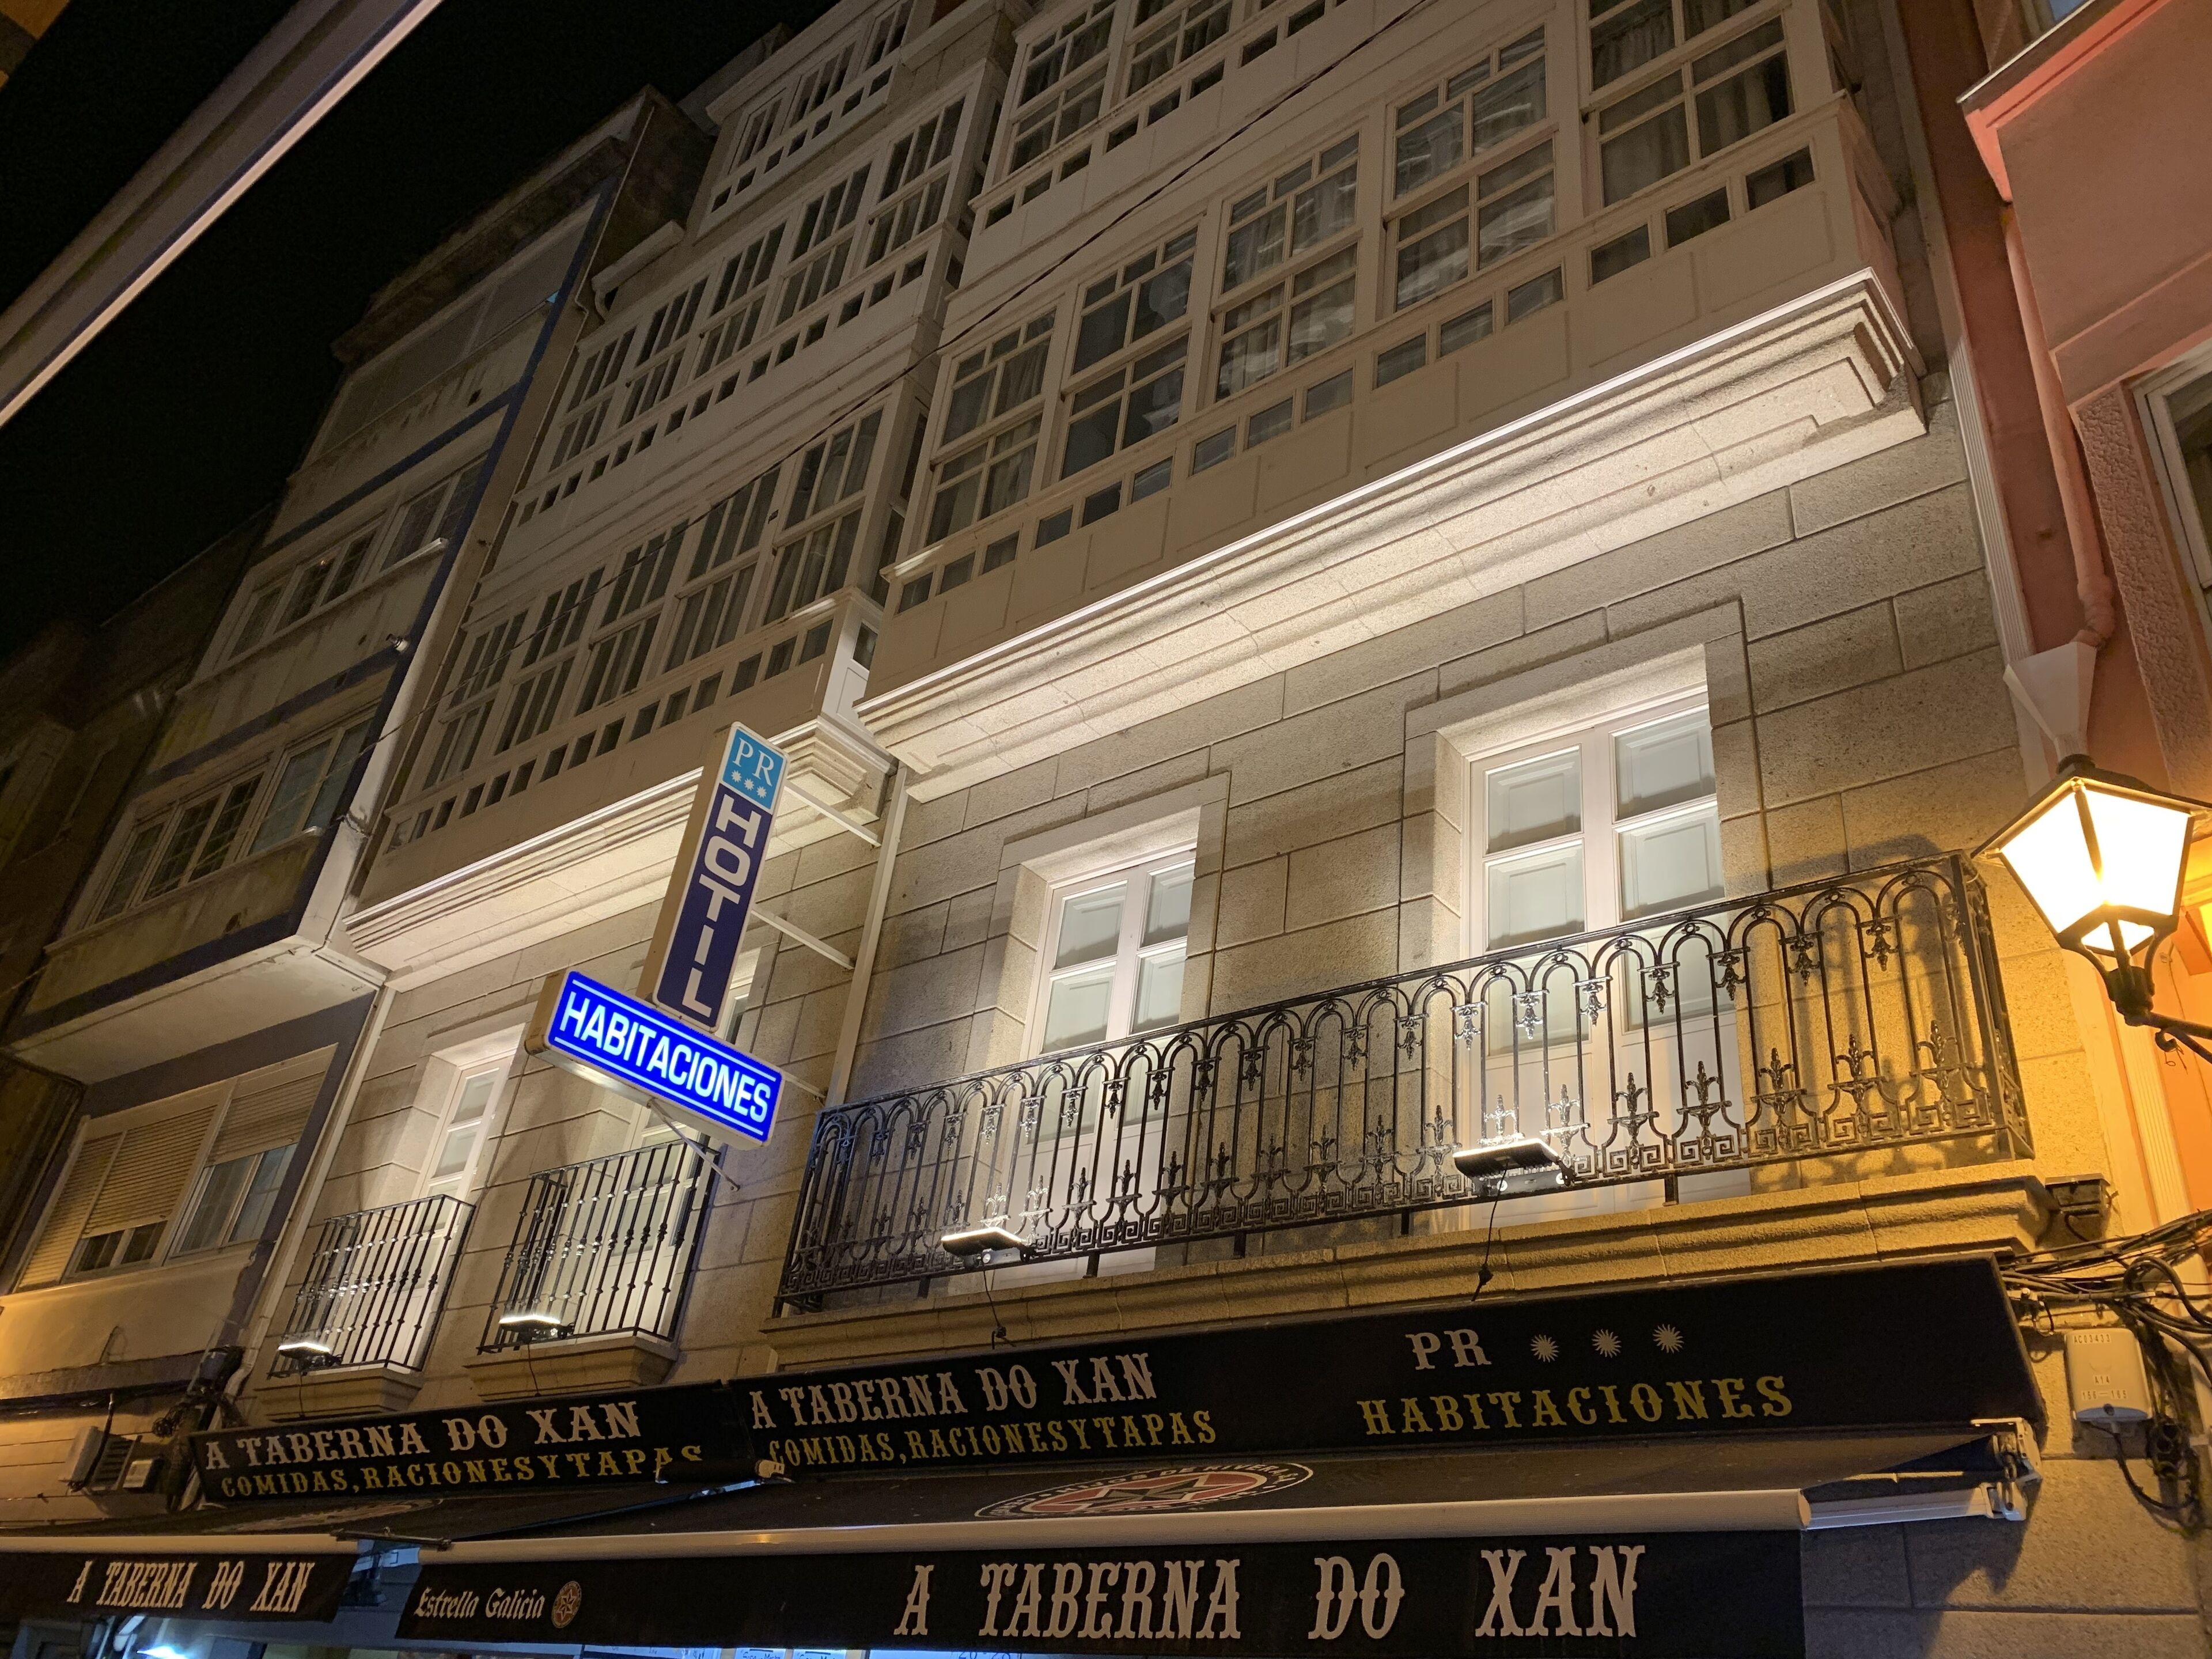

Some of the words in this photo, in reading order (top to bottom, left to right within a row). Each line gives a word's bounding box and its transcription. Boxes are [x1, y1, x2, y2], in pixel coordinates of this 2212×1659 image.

[732, 737, 774, 787] PR
[559, 991, 771, 1123] HABITACIONES
[1406, 1328, 1492, 1370] PR
[2074, 1334, 2111, 1344] AC03433
[749, 1390, 777, 1429] A
[779, 1371, 968, 1426] TABERNA
[975, 1365, 1037, 1412] DO
[1052, 1353, 1158, 1406] XAN
[1357, 1376, 1793, 1435] HABITACIONES
[206, 1441, 230, 1470] A
[237, 1422, 430, 1467] TABERNA
[447, 1414, 509, 1451] DO
[526, 1401, 642, 1445] XAN
[67, 1560, 93, 1603] A
[96, 1562, 198, 1608] TABERNA
[202, 1561, 244, 1609] DO
[250, 1562, 315, 1612] XAN
[414, 1586, 479, 1618] Estrella
[485, 1588, 545, 1619] Galicia
[893, 1564, 933, 1635] A
[978, 1559, 1241, 1640] TABERNA
[1308, 1553, 1406, 1640] DO
[1475, 1545, 1646, 1638] XAN
